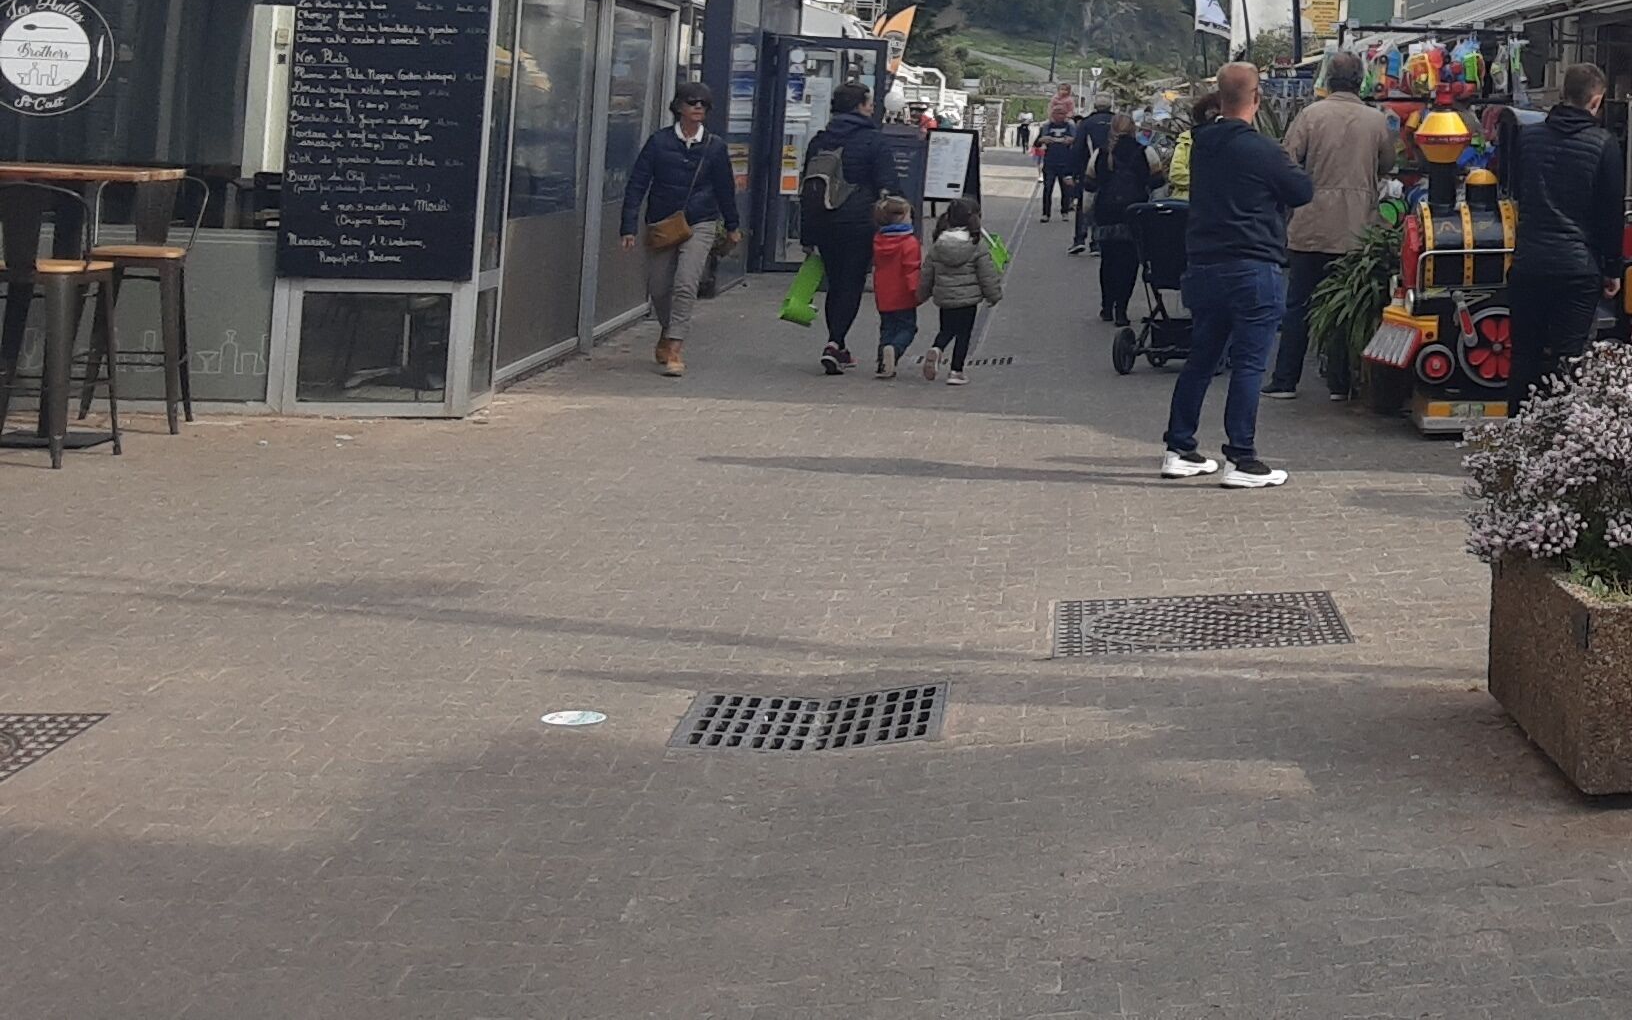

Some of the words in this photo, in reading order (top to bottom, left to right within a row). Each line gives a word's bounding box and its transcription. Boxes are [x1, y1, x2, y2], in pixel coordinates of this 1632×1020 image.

[6, 0, 31, 20] Les
[17, 41, 71, 59] Brothers
[34, 95, 67, 111] Cast
